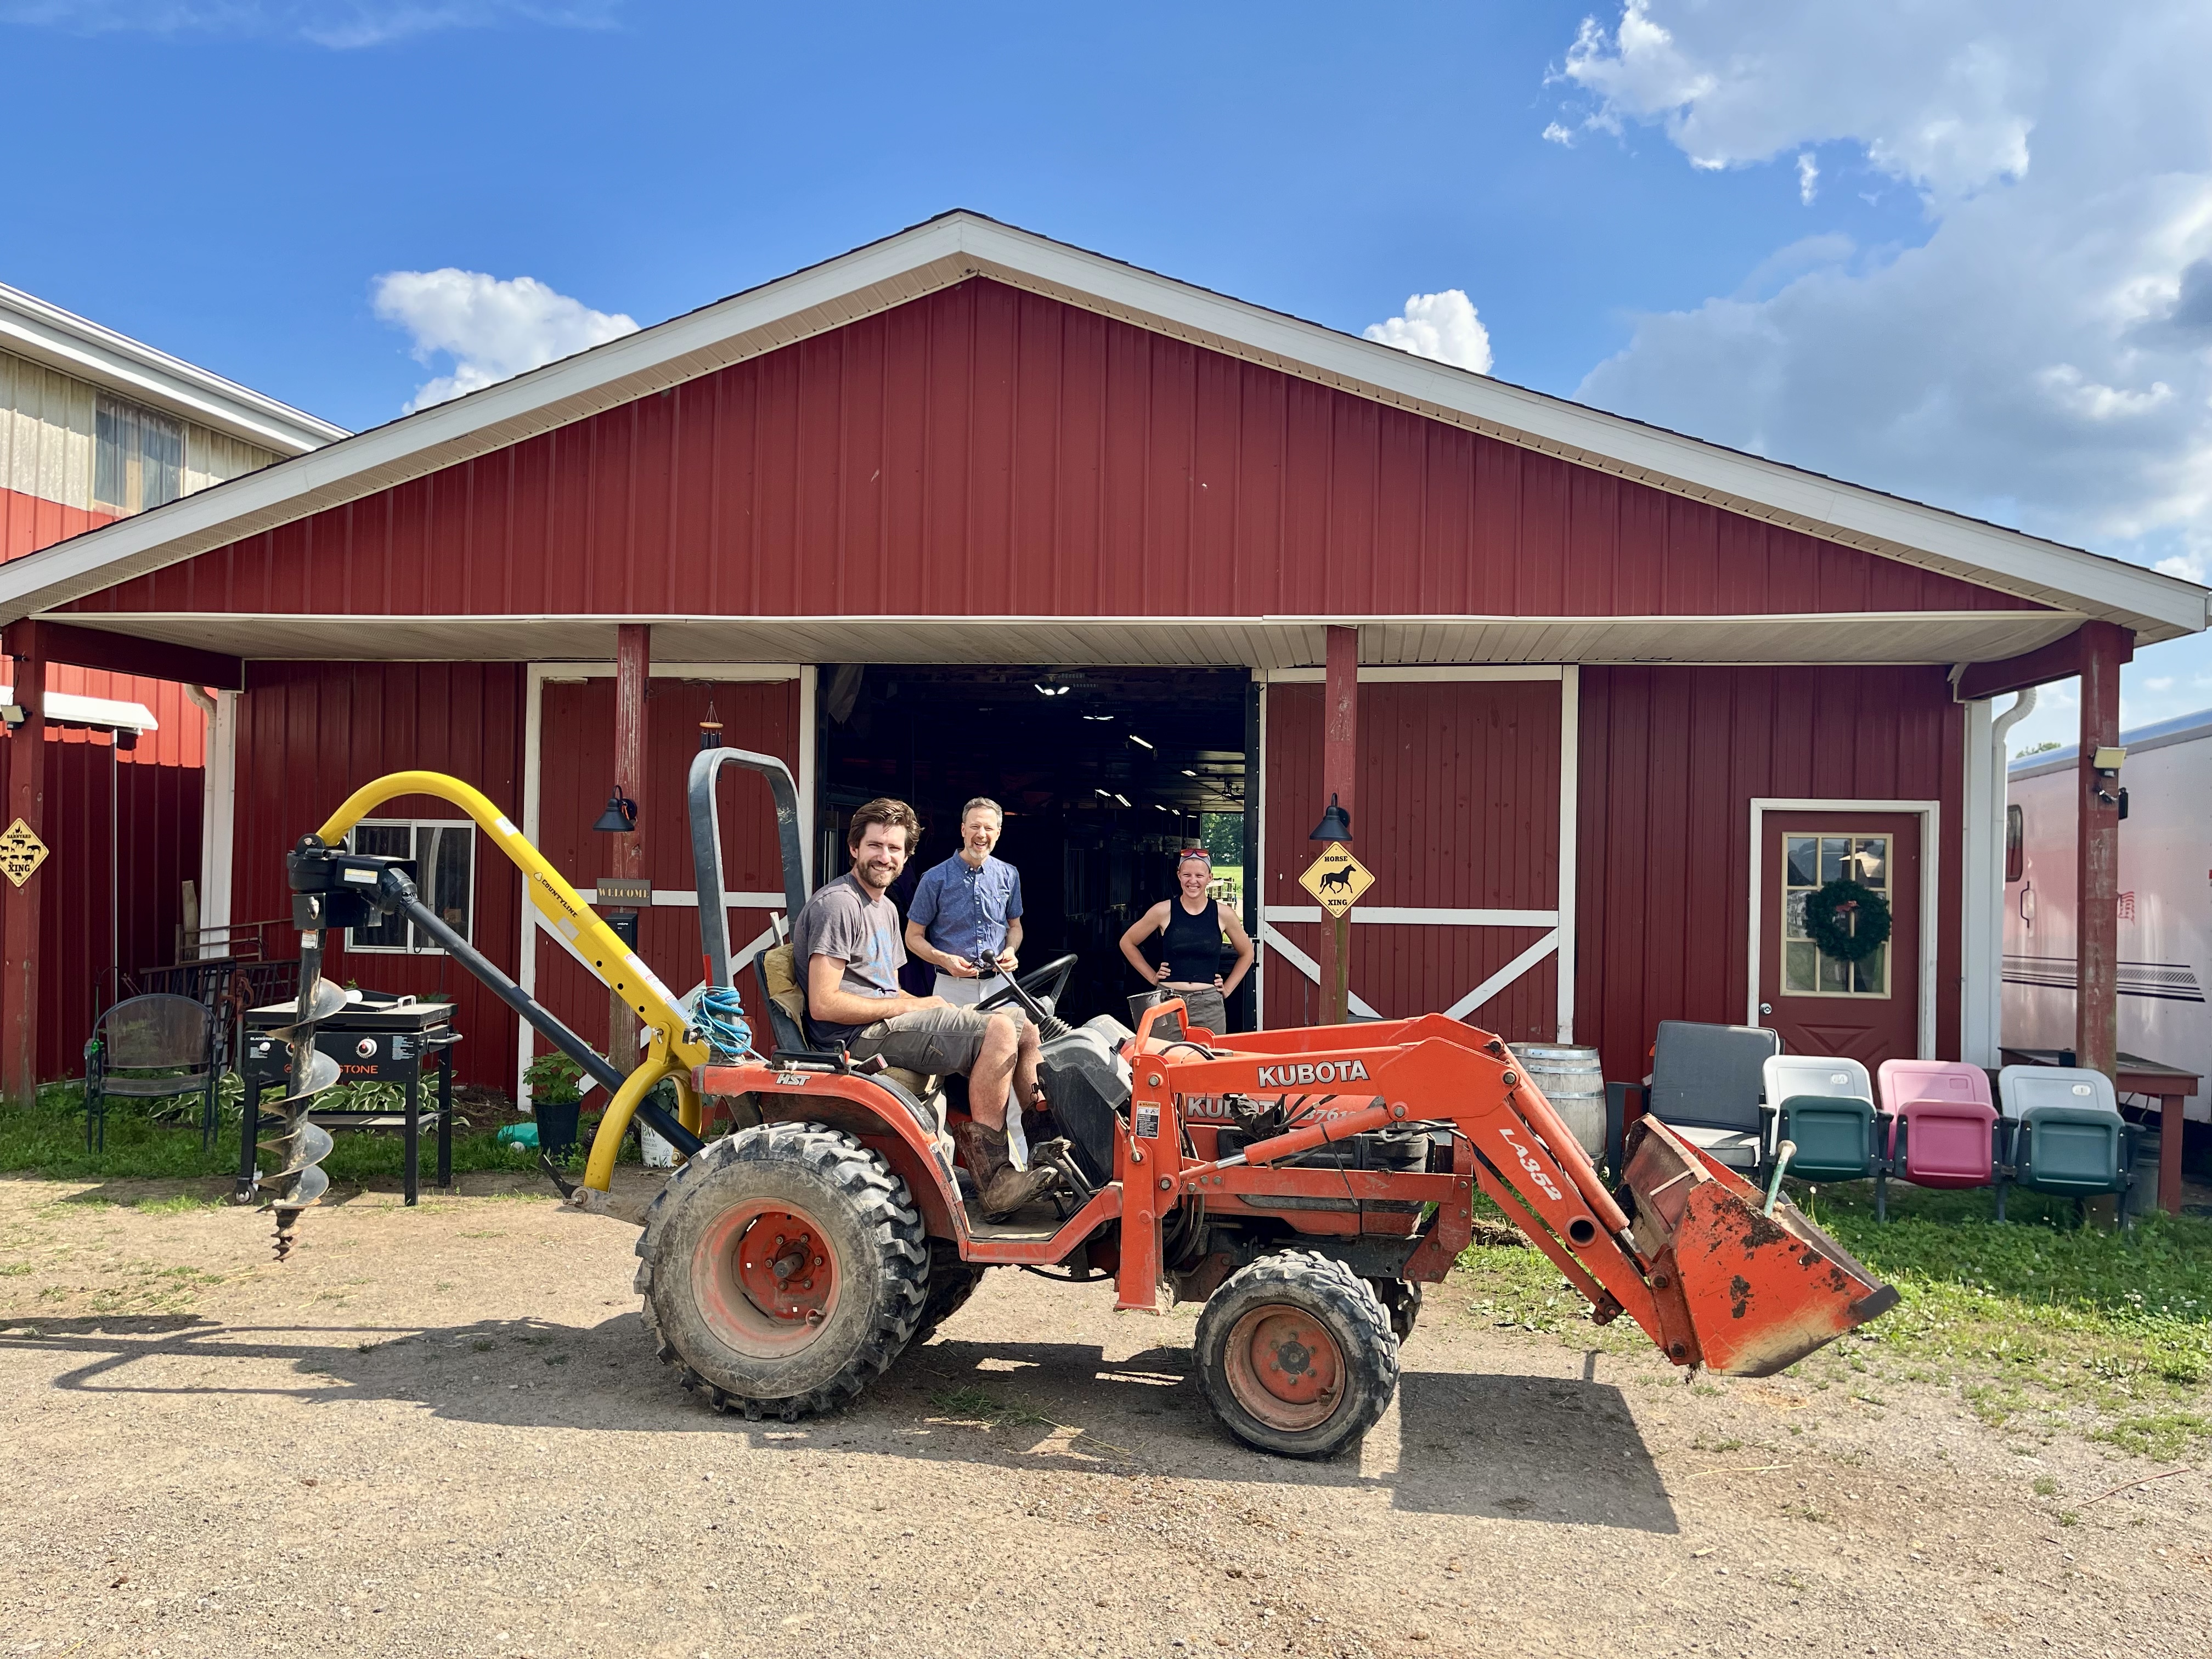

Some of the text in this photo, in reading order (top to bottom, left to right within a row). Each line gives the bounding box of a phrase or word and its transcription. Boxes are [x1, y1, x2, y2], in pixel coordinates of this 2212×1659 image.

[541, 879, 578, 918] COUNTYLINE
[598, 888, 650, 898] WELCOME
[339, 1065, 378, 1074] STONE
[1258, 1059, 1370, 1087] KUBOTA
[776, 1074, 811, 1086] HST
[1498, 1128, 1562, 1200] LA352
